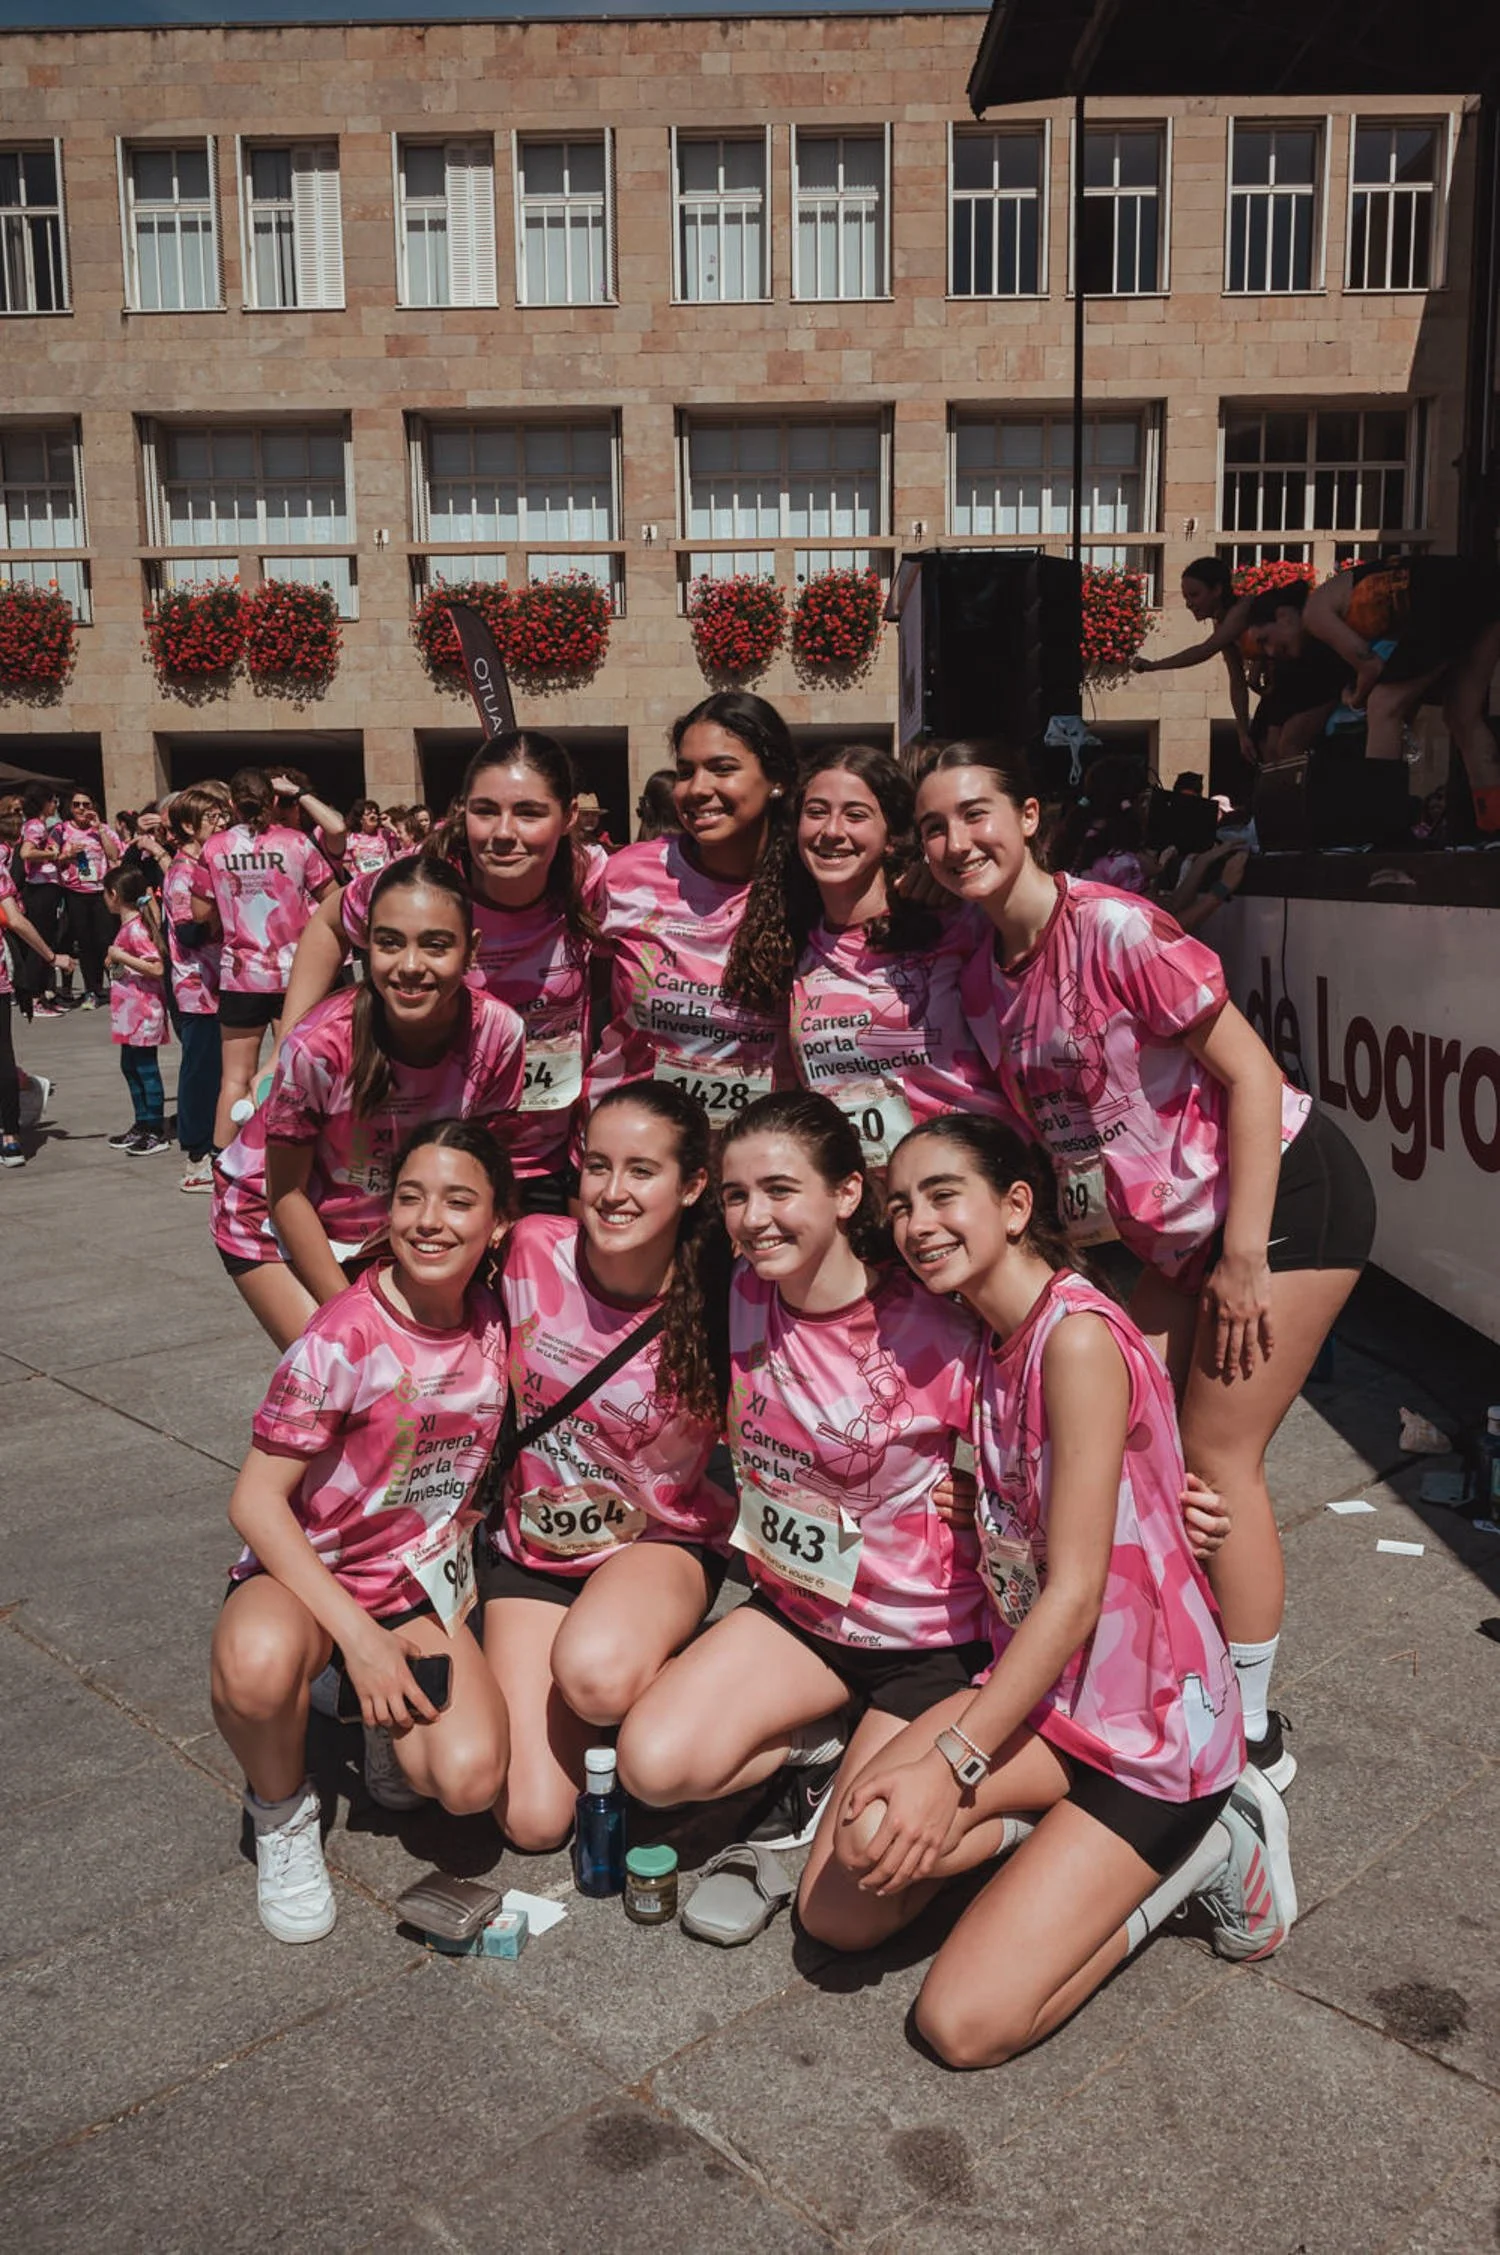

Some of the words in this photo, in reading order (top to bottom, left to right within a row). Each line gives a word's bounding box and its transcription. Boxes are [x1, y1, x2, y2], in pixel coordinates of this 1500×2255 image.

[659, 949, 678, 968] XI
[655, 972, 732, 999] Carrera
[652, 999, 683, 1018] por
[689, 1001, 707, 1019] la
[804, 995, 822, 1011] XI
[801, 1013, 871, 1032] Carrera
[1246, 956, 1310, 1093] de
[803, 1041, 832, 1060] por
[835, 1036, 854, 1052] la
[808, 1049, 933, 1080] Investigación
[673, 1076, 750, 1110] 1428
[524, 1367, 543, 1392] XI
[746, 1390, 768, 1417] XI
[418, 1414, 436, 1434] XI
[415, 1434, 473, 1457] Carrera
[740, 1419, 811, 1468] Carrera
[410, 1462, 435, 1485] por
[436, 1457, 451, 1474] la
[773, 1459, 791, 1484] la
[538, 1499, 626, 1537] 3964
[760, 1504, 826, 1564] 843
[847, 1630, 882, 1645] Ferrer
